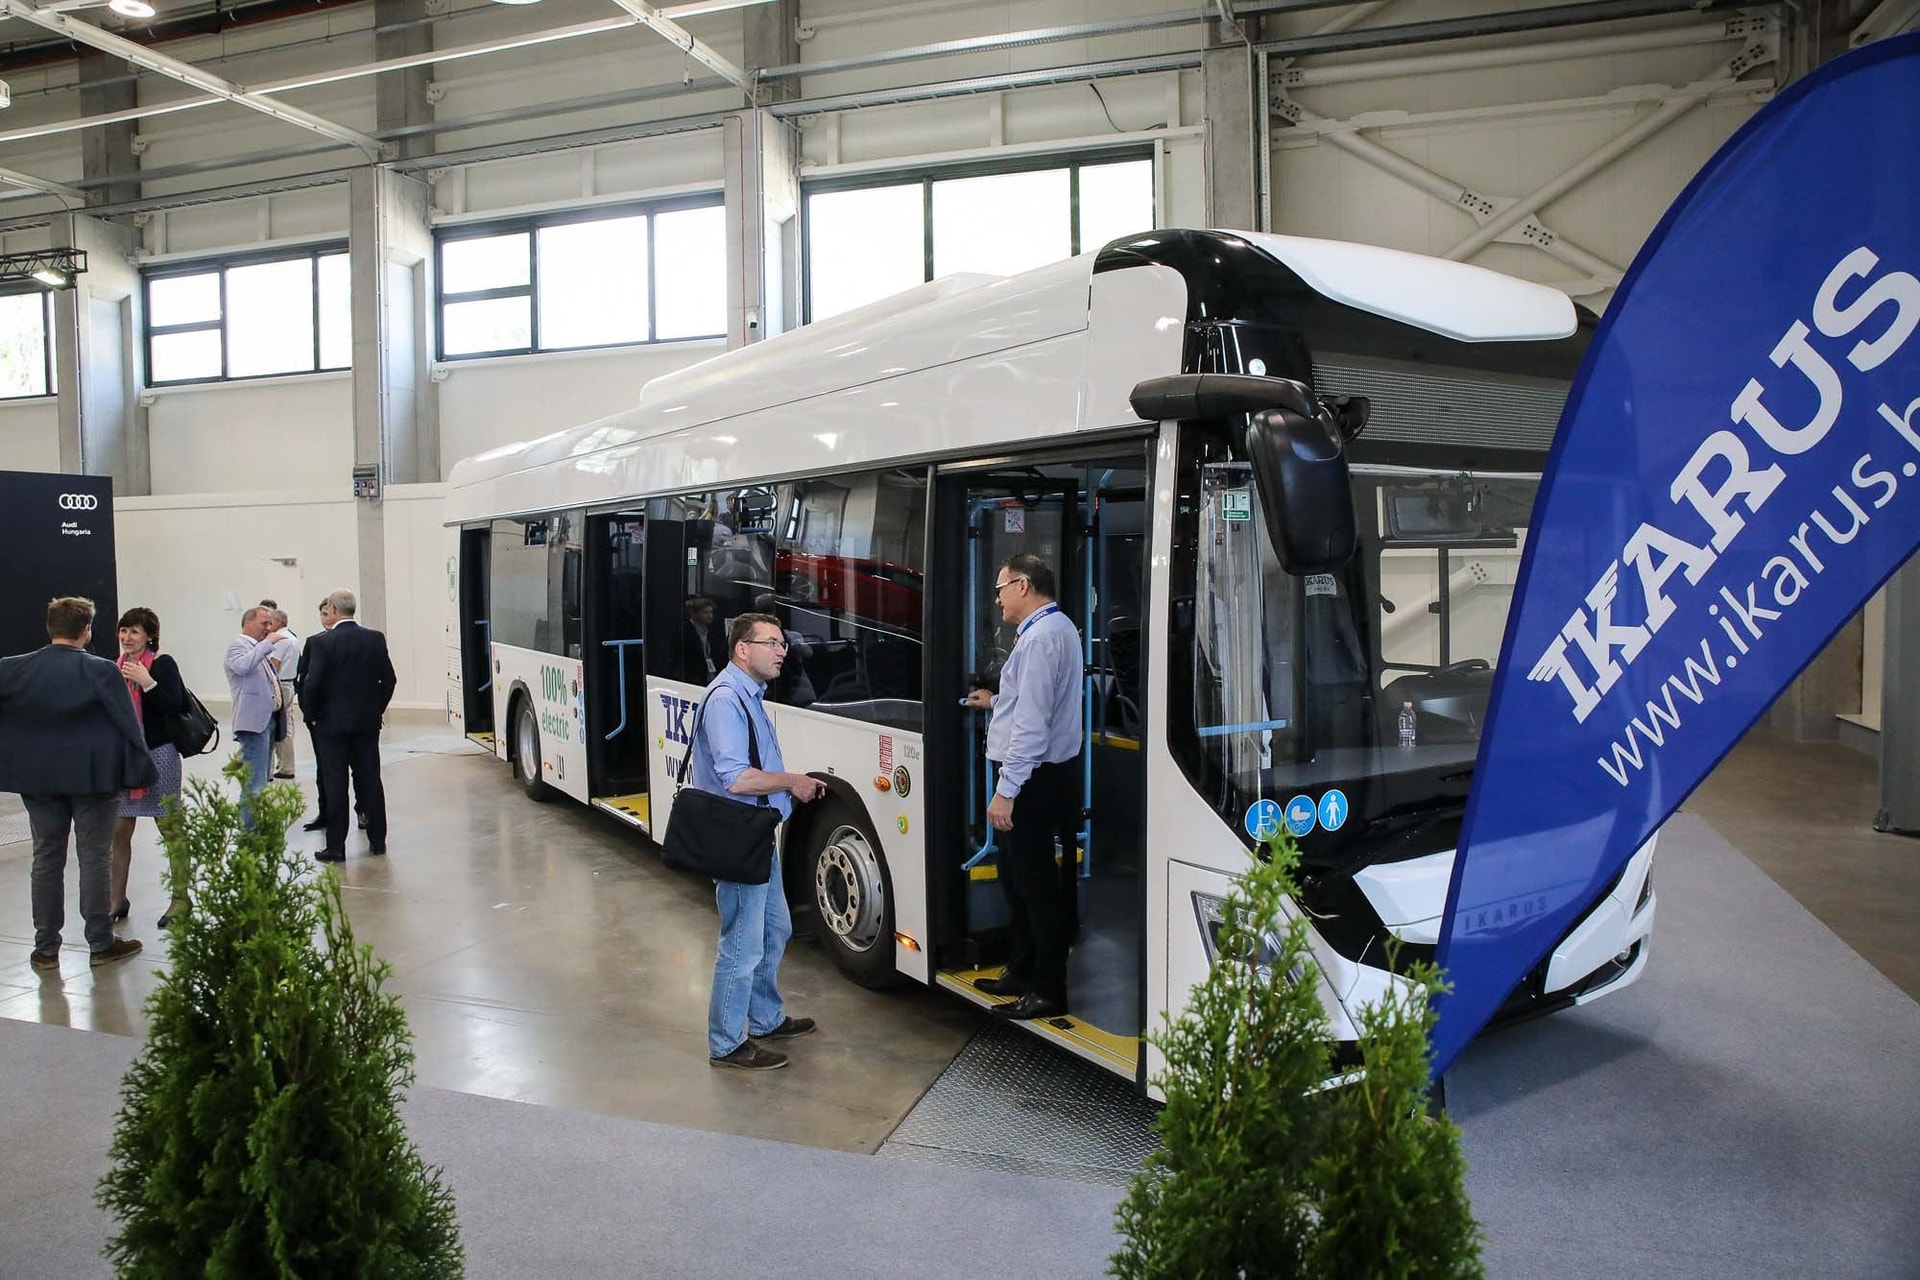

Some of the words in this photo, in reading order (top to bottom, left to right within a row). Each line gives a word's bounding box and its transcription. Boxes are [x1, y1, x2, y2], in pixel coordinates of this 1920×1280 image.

[1527, 246, 1920, 724] IKARUS
[61, 528, 92, 536] Hungaria
[540, 664, 568, 706] 100%
[541, 706, 570, 741] electric
[1465, 896, 1546, 931] IKARUS
